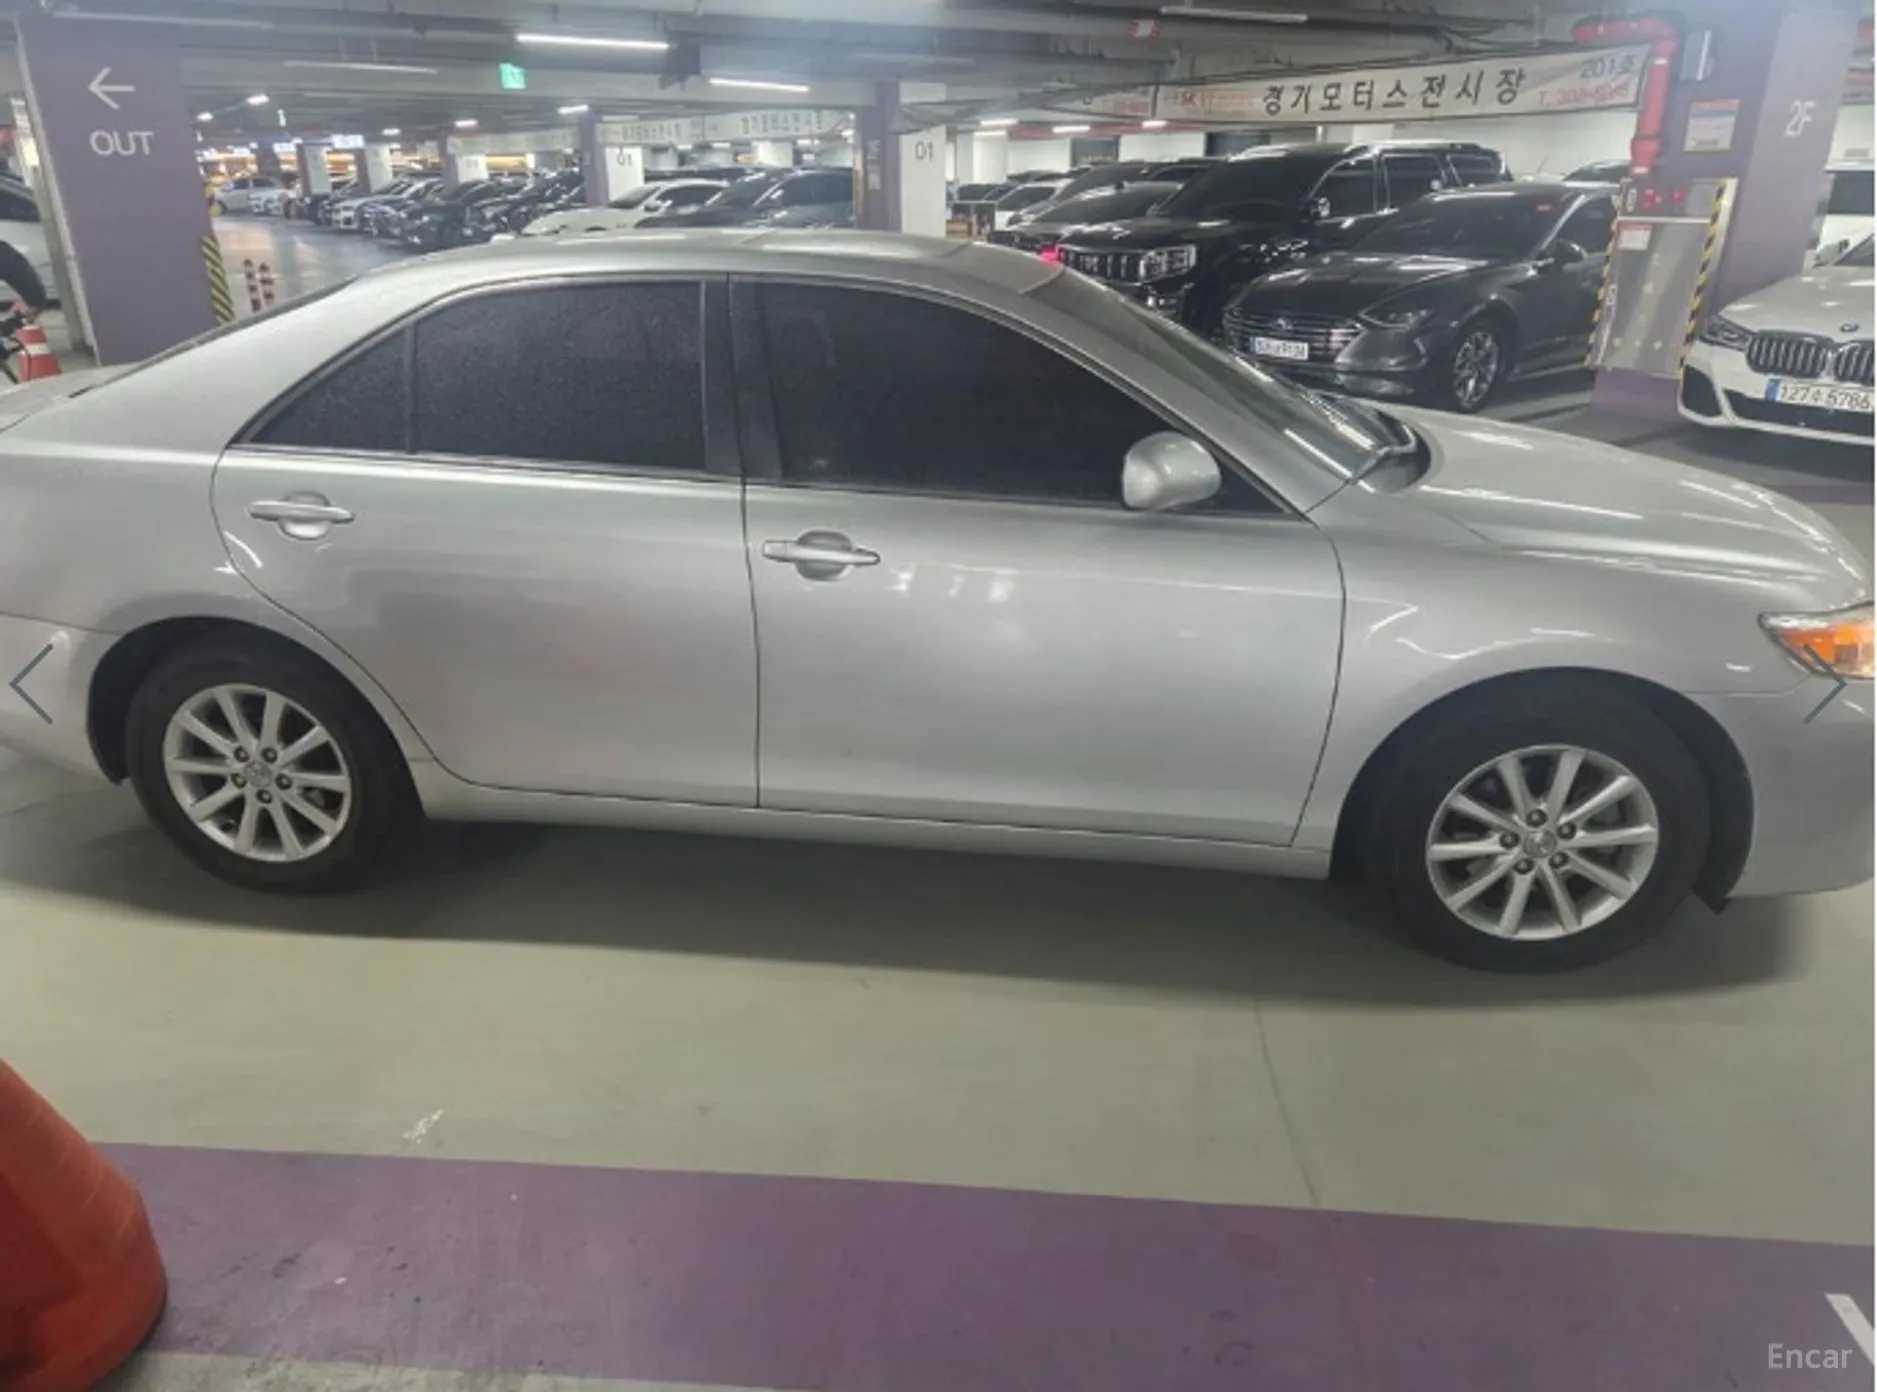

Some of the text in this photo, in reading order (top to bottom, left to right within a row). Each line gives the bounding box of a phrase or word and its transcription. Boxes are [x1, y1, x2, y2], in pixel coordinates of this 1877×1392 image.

[1785, 100, 1817, 137] 2F
[89, 130, 155, 156] OUT
[915, 140, 933, 161] 01
